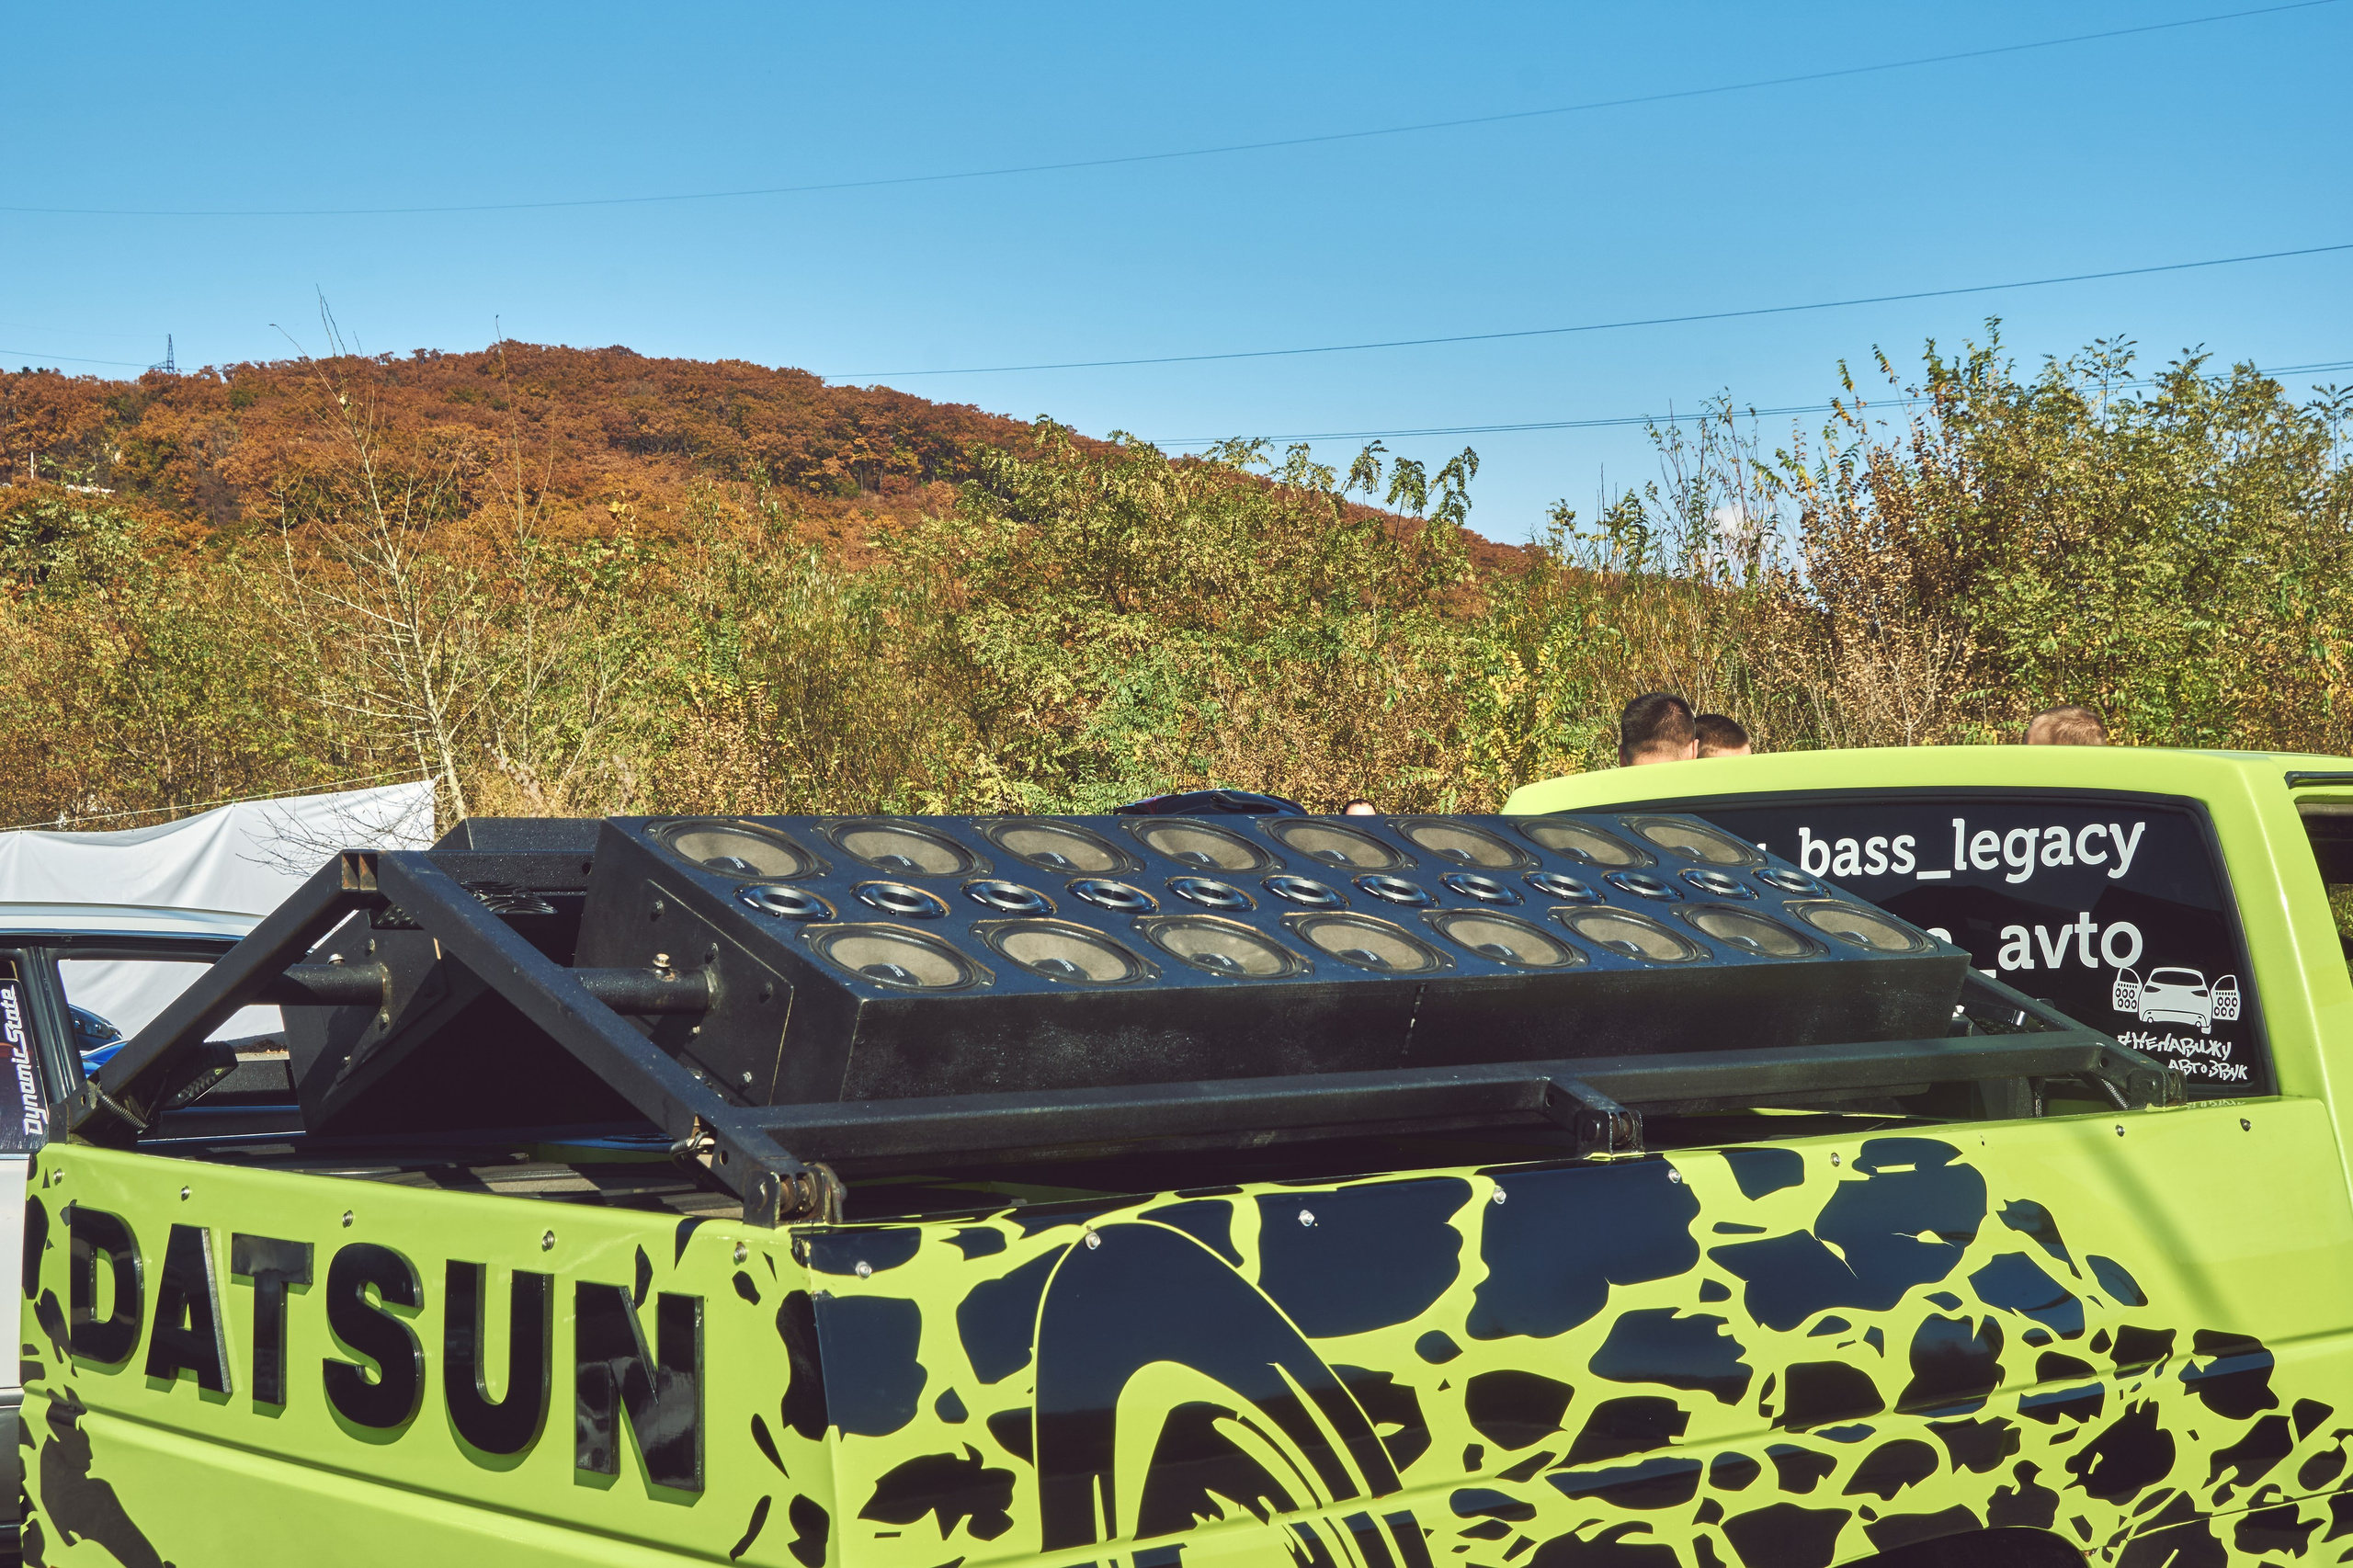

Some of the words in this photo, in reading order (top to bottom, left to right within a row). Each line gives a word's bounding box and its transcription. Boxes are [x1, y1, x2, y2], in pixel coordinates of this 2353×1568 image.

[0, 984, 28, 1053] State
[11, 1047, 49, 1136] Dynamic
[69, 1203, 705, 1494] DATSUN
